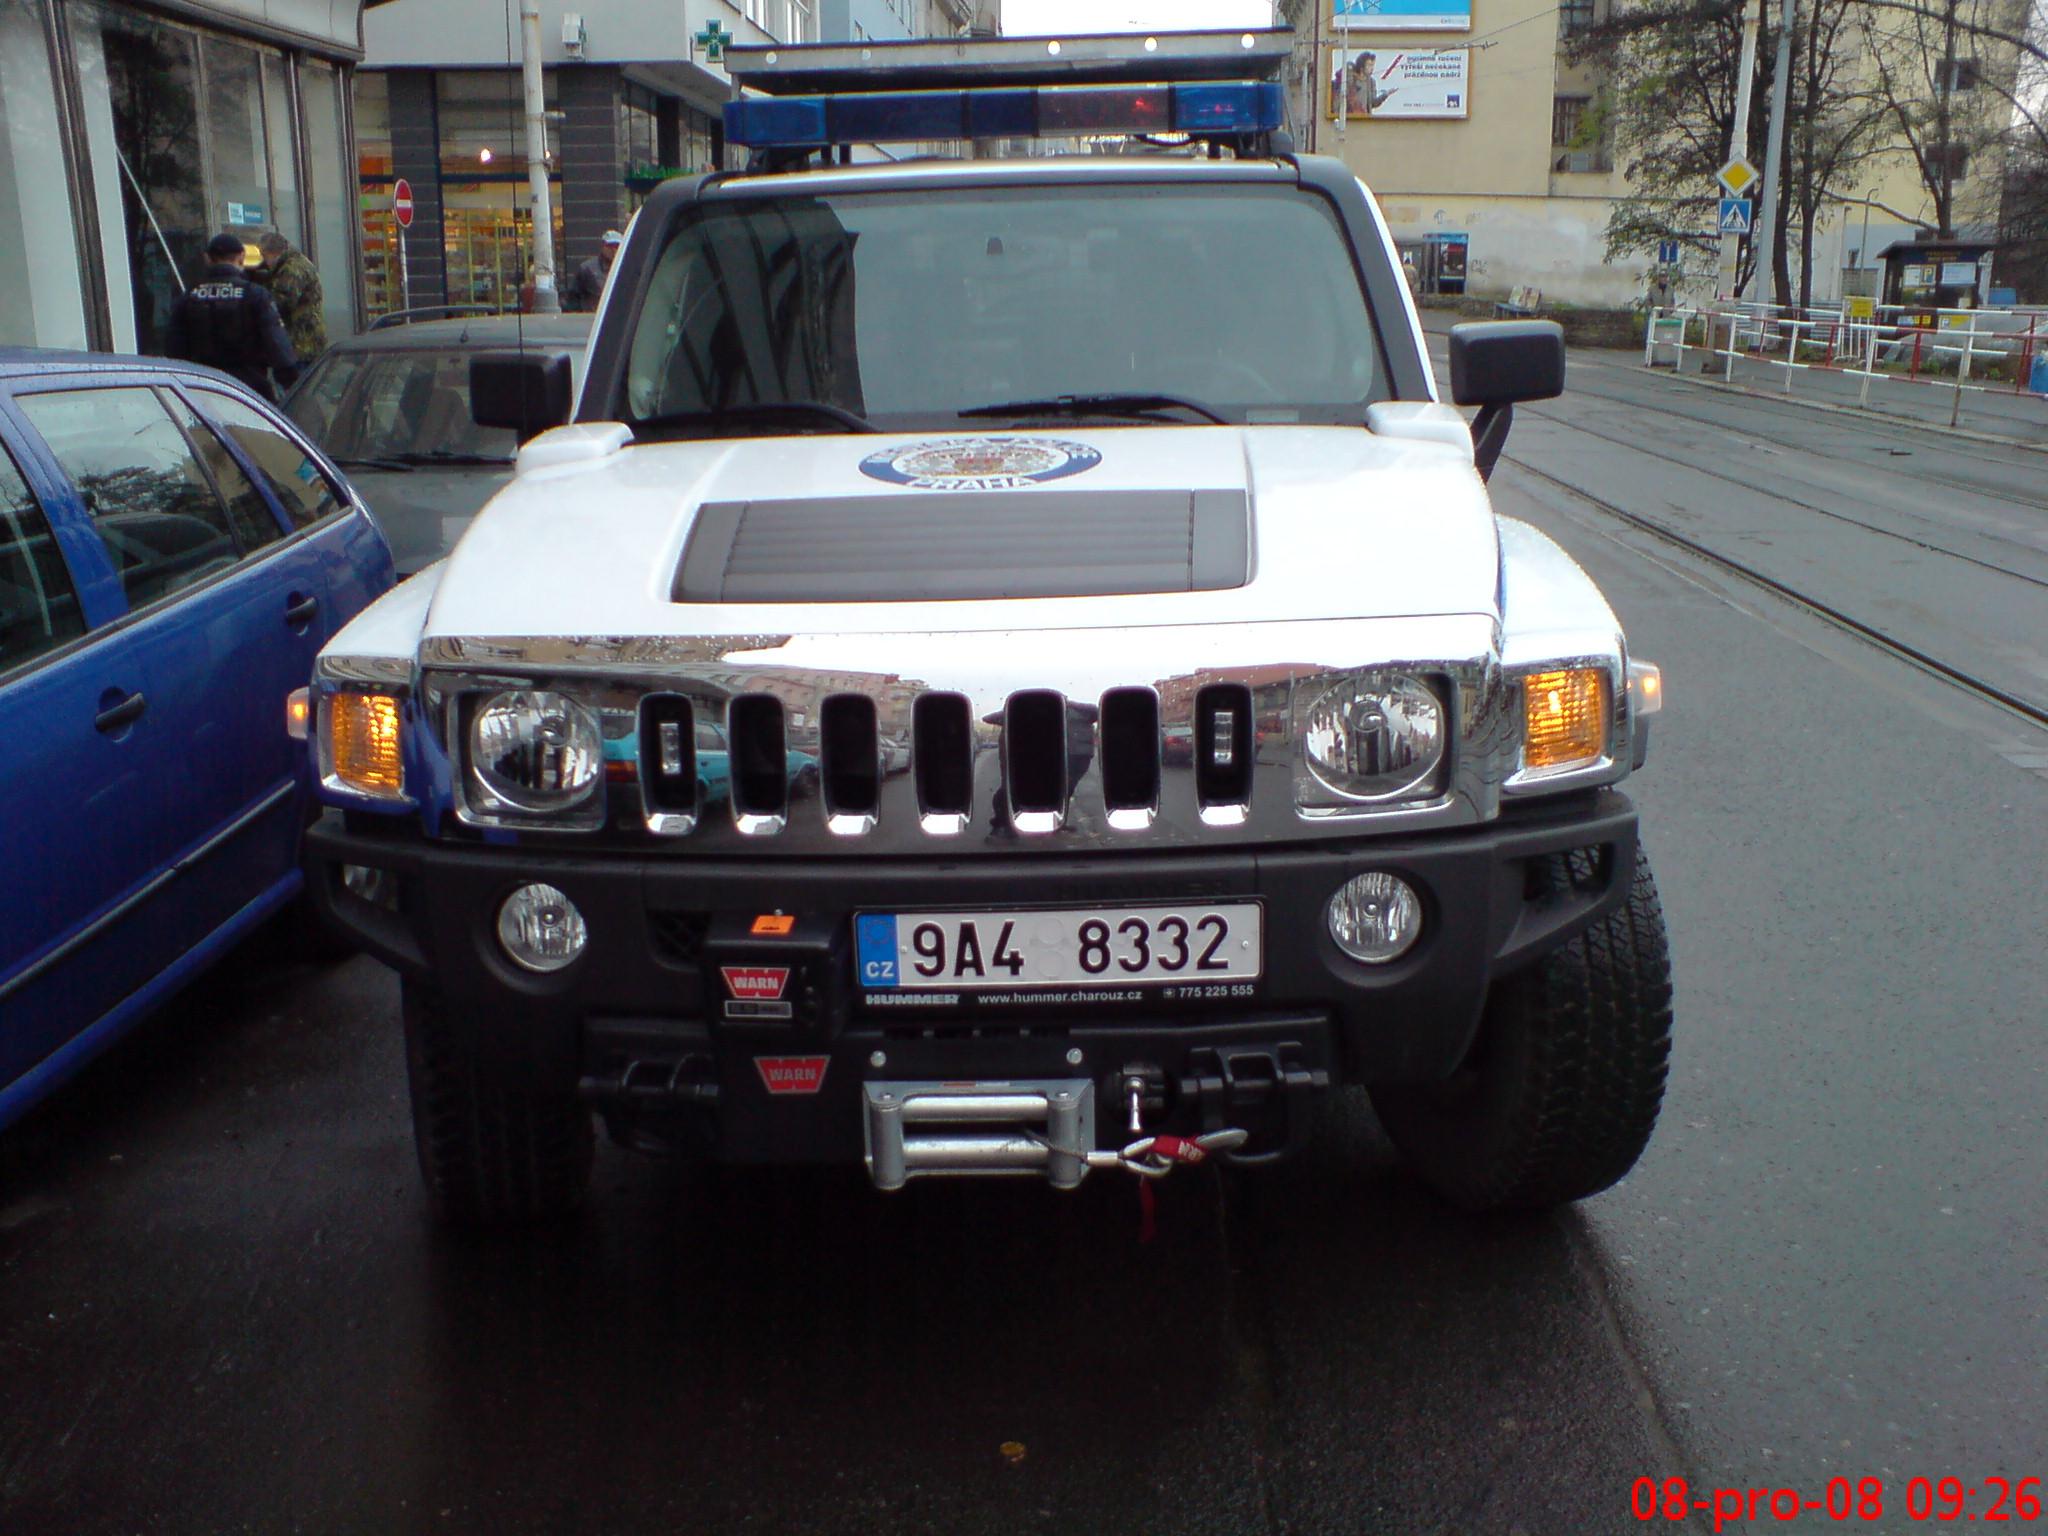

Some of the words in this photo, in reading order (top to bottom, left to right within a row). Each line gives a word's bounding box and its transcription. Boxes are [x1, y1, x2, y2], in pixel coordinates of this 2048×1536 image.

[912, 919, 1025, 978] 9A4
[1078, 913, 1230, 975] 8332
[865, 961, 895, 978] CZ
[734, 975, 779, 990] WARN
[865, 993, 961, 1006] HUMMER
[977, 988, 1143, 1005] www.hummer.charouz.cz
[1179, 986, 1202, 999] 775
[1205, 985, 1228, 998] 225
[1231, 984, 1255, 997] 555
[768, 1067, 818, 1083] WARN
